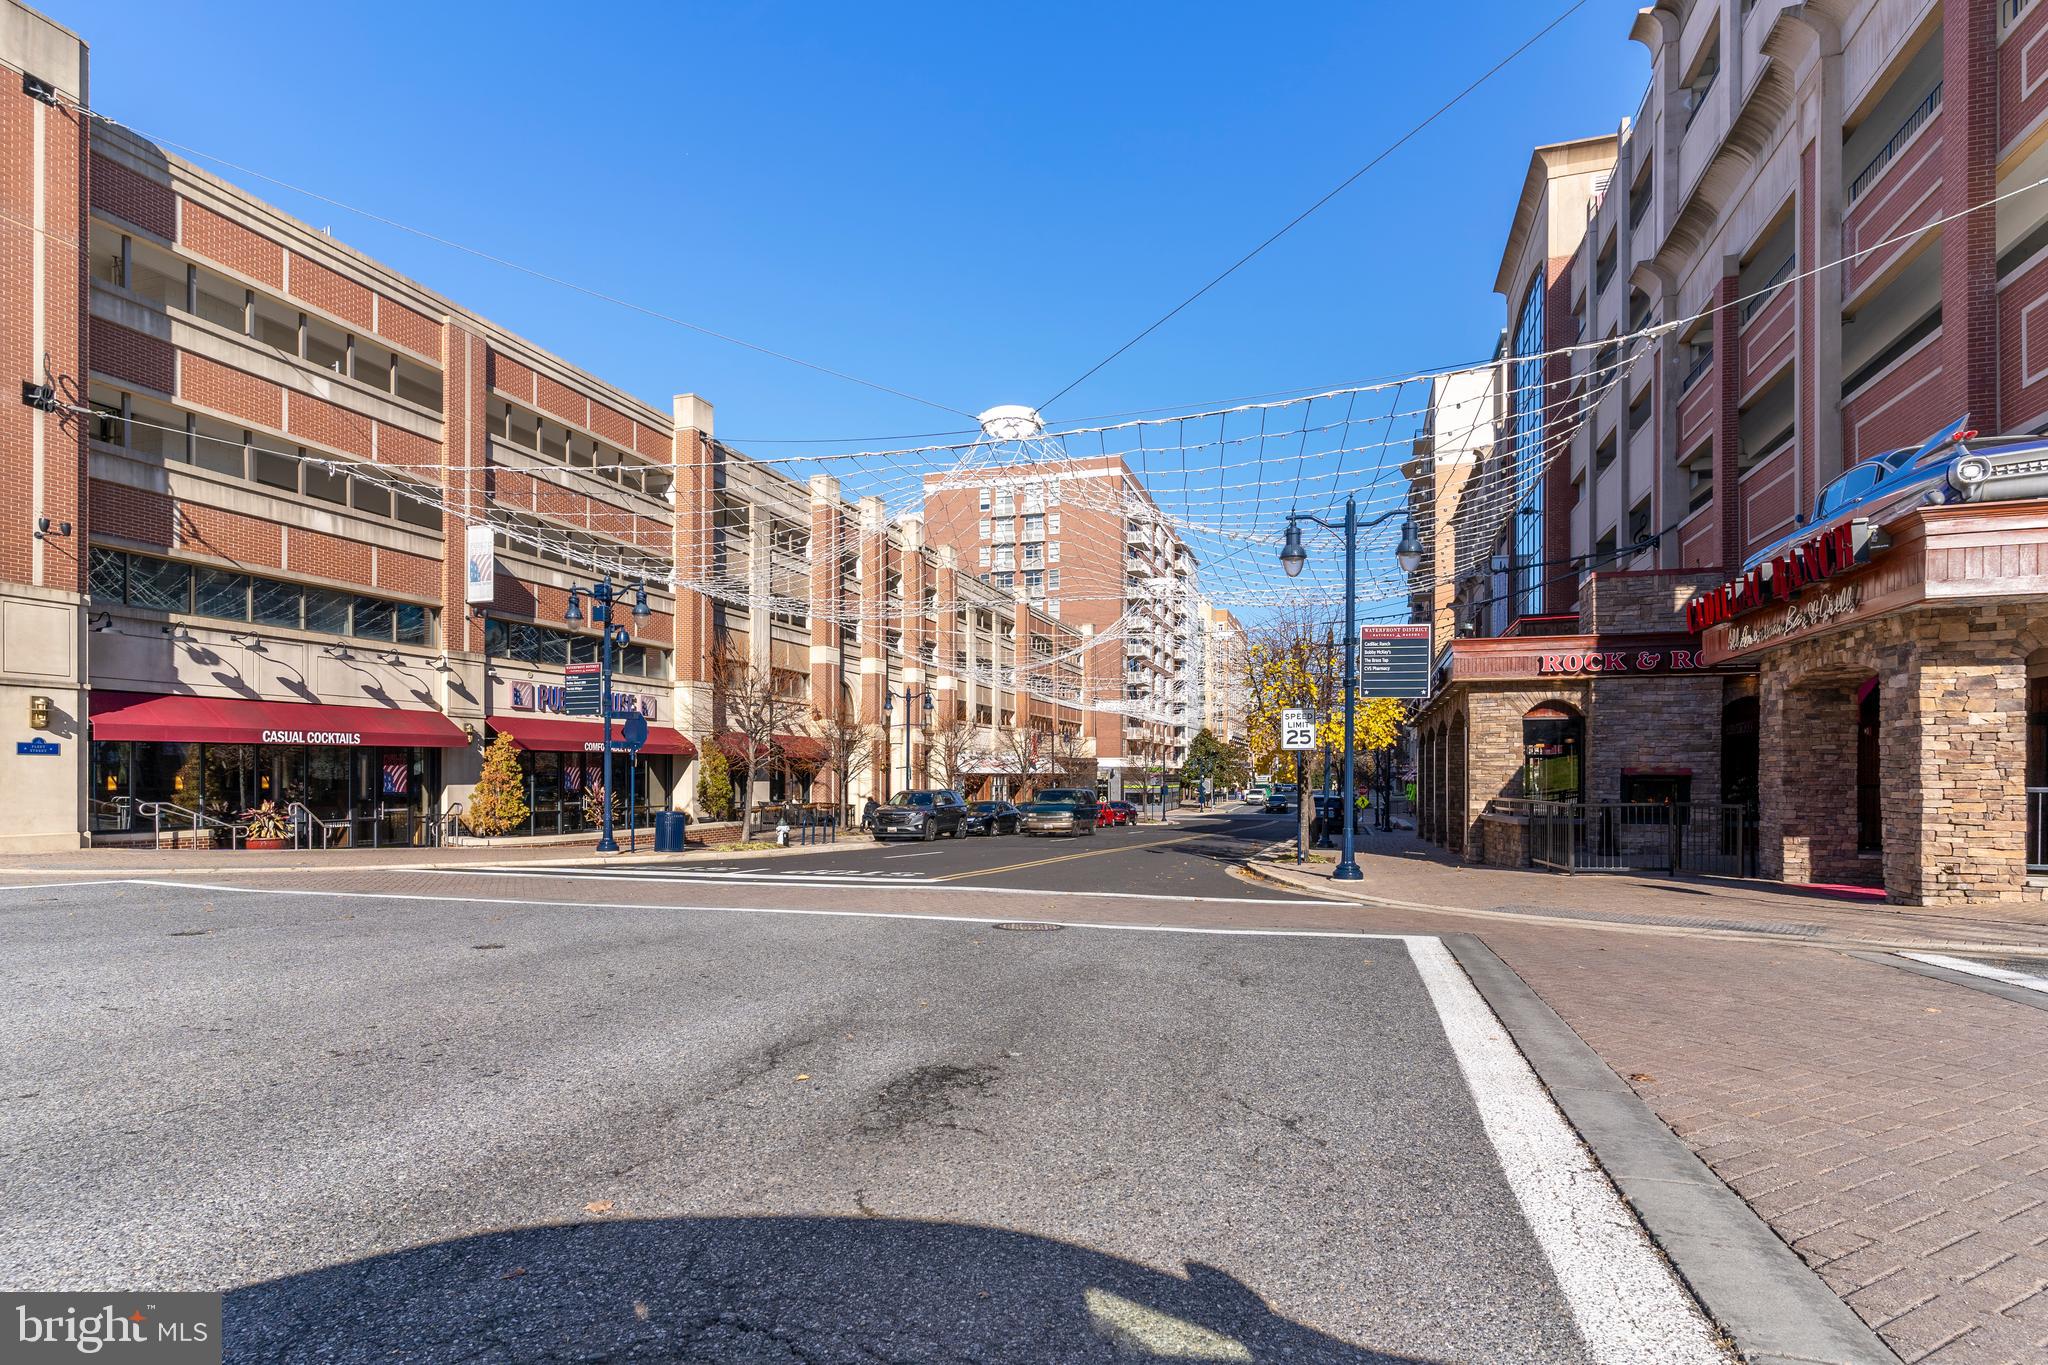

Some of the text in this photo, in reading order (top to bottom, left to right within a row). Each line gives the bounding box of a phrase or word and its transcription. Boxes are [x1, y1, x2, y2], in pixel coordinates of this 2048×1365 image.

[1771, 519, 1855, 601] RANCH
[1542, 650, 1704, 672] ROCK & RO
[262, 730, 361, 745] CASUAL COCKTAILS
[1286, 730, 1312, 745] 25
